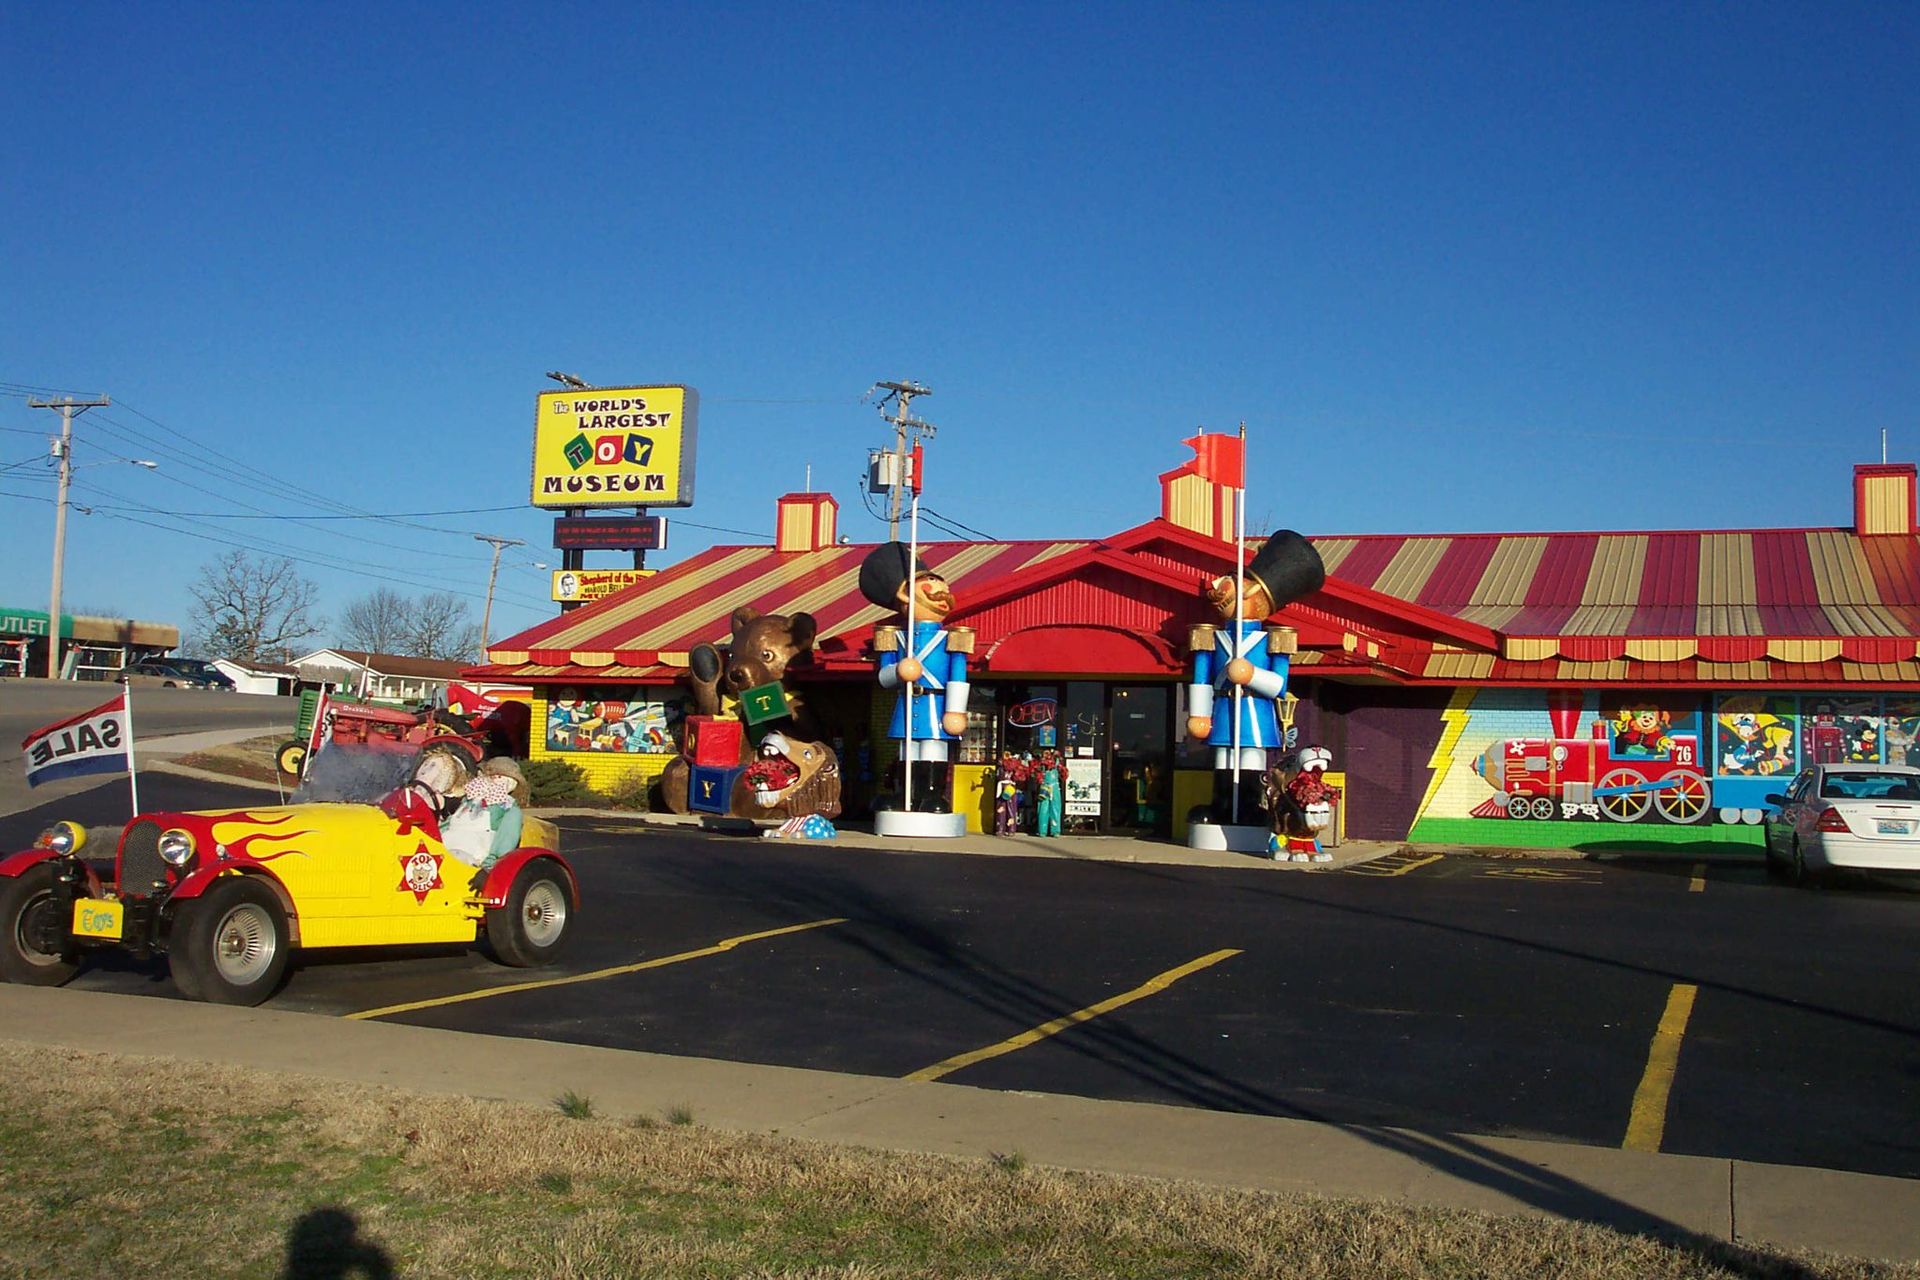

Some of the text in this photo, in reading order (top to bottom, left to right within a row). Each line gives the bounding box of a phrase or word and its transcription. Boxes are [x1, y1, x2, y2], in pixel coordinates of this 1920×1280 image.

[553, 398, 646, 415] The WORLD'S
[578, 413, 671, 429] LARGEST
[566, 441, 651, 465] TOY
[543, 474, 665, 493] MUSEUM
[580, 573, 613, 586] Shepherd
[614, 573, 622, 584] of
[622, 573, 634, 584] the
[1009, 703, 1056, 722] OPEN
[1676, 745, 1692, 762] 76
[411, 855, 432, 866] TOY
